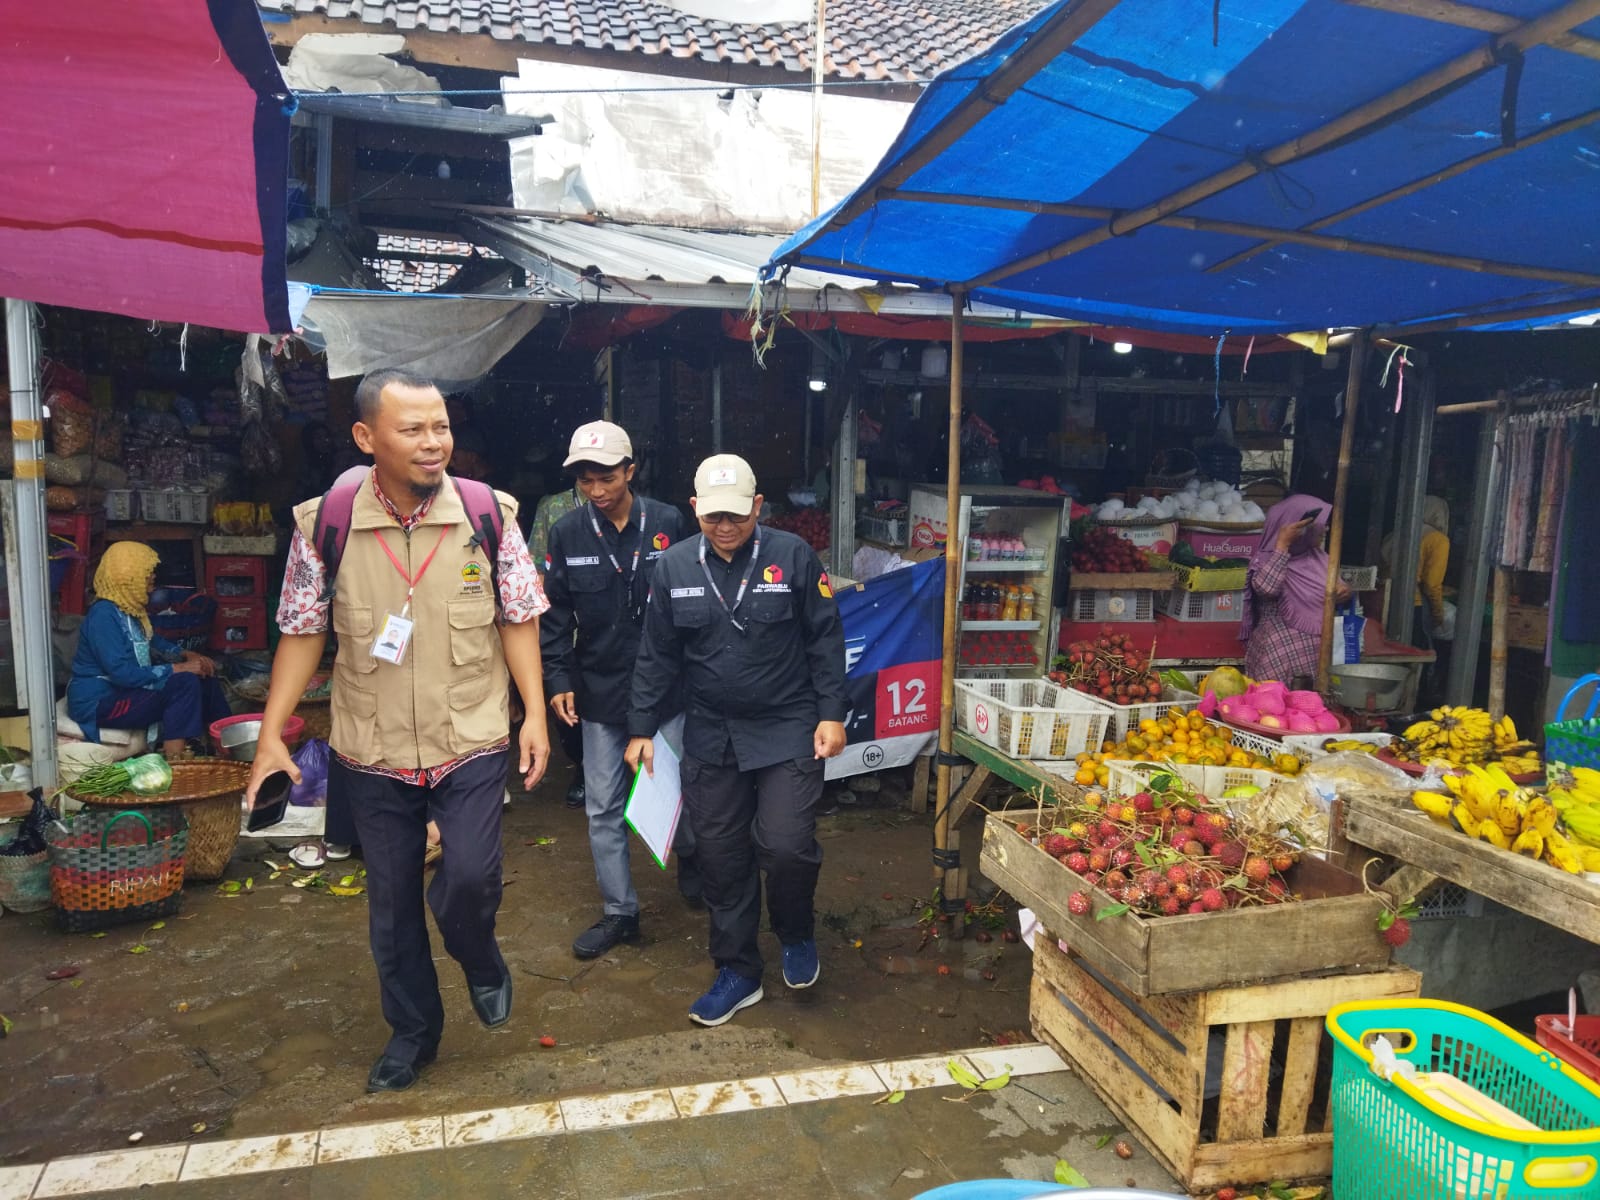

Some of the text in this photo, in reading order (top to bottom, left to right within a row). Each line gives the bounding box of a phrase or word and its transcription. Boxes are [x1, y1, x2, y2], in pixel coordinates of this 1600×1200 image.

[1202, 542, 1252, 553] HuaGuang
[1217, 594, 1232, 607] HS
[886, 678, 927, 716] 12
[888, 713, 928, 728] BATANG
[865, 751, 882, 763] 18+
